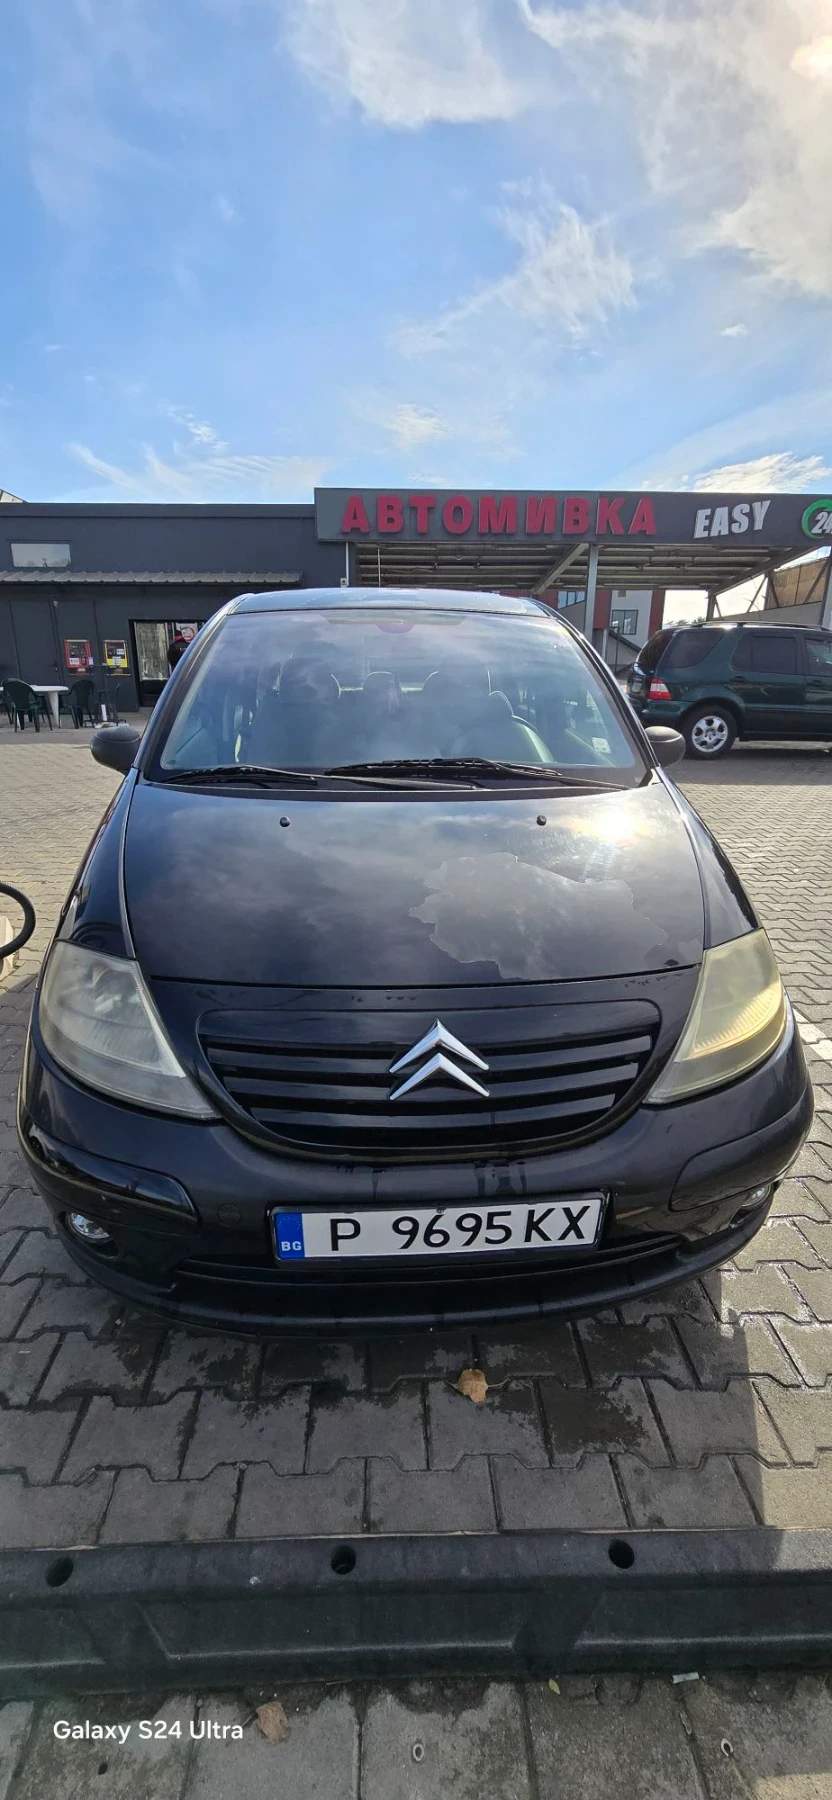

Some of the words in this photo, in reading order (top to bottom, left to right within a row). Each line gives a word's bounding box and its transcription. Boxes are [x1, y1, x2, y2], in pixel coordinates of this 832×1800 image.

[341, 495, 658, 535] АВТОМИВКА
[694, 500, 770, 538] EASY
[281, 1240, 302, 1251] BG
[330, 1218, 361, 1251] P
[391, 1213, 513, 1249] 9695
